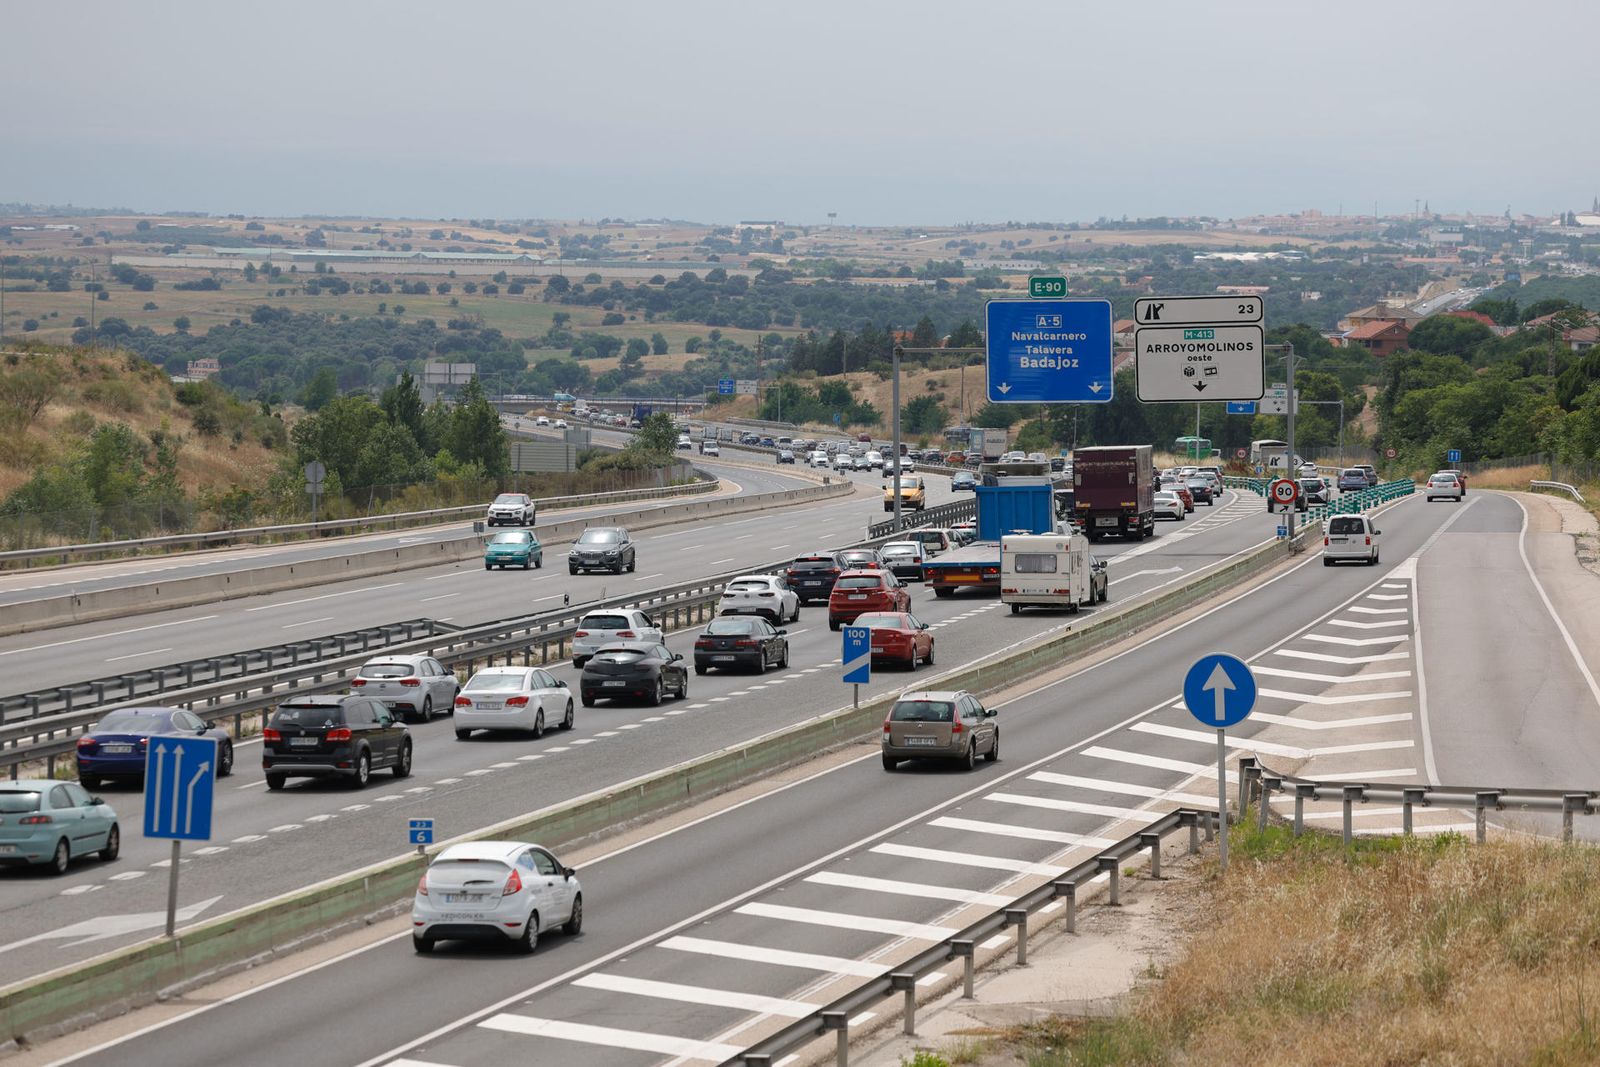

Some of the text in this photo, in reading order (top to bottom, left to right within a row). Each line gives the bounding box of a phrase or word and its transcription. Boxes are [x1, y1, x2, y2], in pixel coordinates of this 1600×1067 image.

[1034, 282, 1062, 293] E-90
[1238, 304, 1254, 314] 23
[1038, 316, 1060, 326] A-5
[1011, 331, 1086, 341] Navalcarnero
[1185, 330, 1213, 339] M-413
[1025, 344, 1073, 355] Talavera
[1146, 342, 1254, 353] ARROYOMOLINOS
[1020, 356, 1079, 369] Badajoz
[1277, 487, 1292, 497] 90
[847, 629, 865, 639] 100
[416, 831, 426, 842] 6
